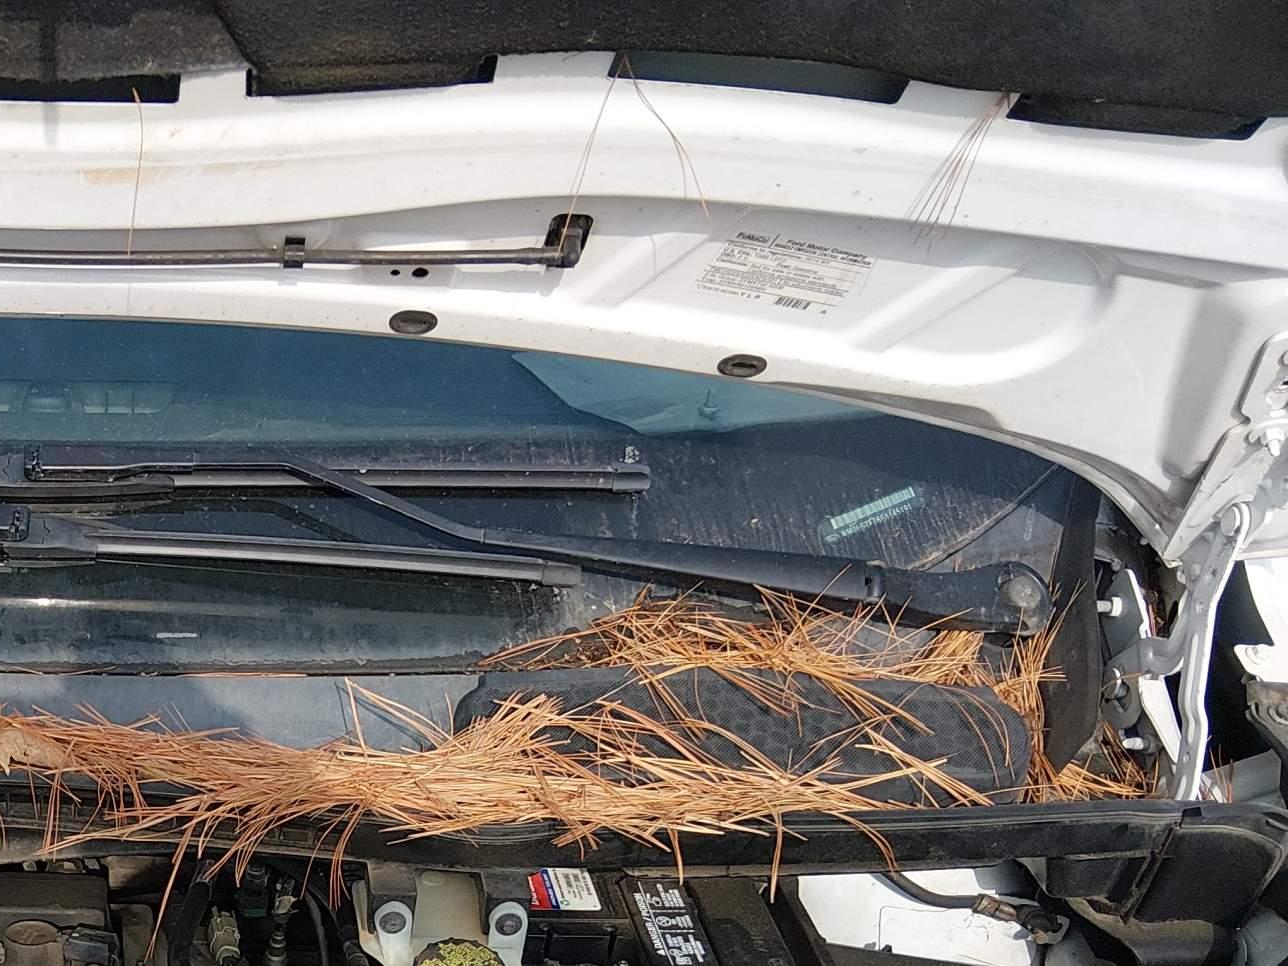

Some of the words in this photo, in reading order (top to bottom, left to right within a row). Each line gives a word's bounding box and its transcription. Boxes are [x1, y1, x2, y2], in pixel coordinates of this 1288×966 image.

[736, 232, 770, 243] FoMoCo
[786, 239, 806, 248] Ford
[806, 243, 830, 251] Motor
[831, 247, 869, 259] Company
[633, 892, 650, 917] POISON
[644, 922, 664, 949] DANGER
